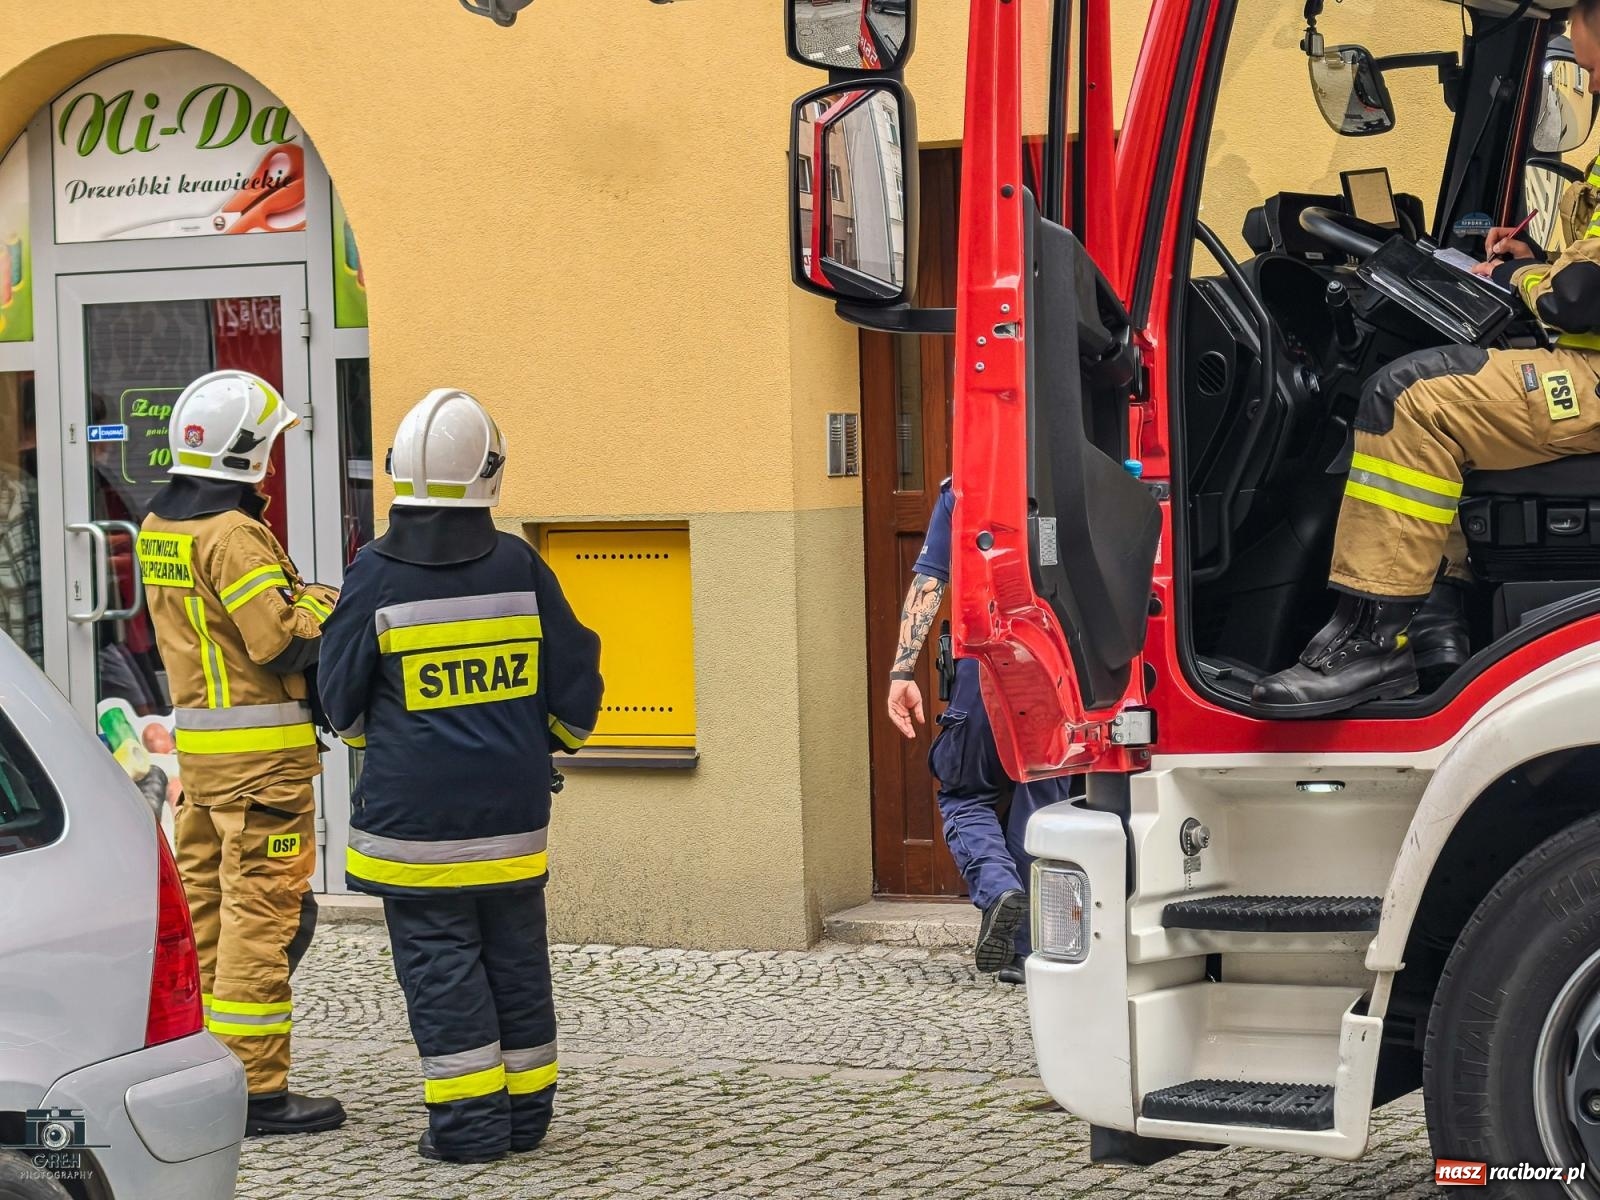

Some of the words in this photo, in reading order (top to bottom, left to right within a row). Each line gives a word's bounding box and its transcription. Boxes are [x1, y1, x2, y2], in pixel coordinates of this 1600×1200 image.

[58, 83, 298, 157] Ni-Da
[65, 175, 171, 204] Przeróbki
[178, 169, 294, 195] krawieckie
[130, 398, 172, 420] Zap
[1547, 375, 1573, 410] PSP
[273, 838, 296, 853] OSP
